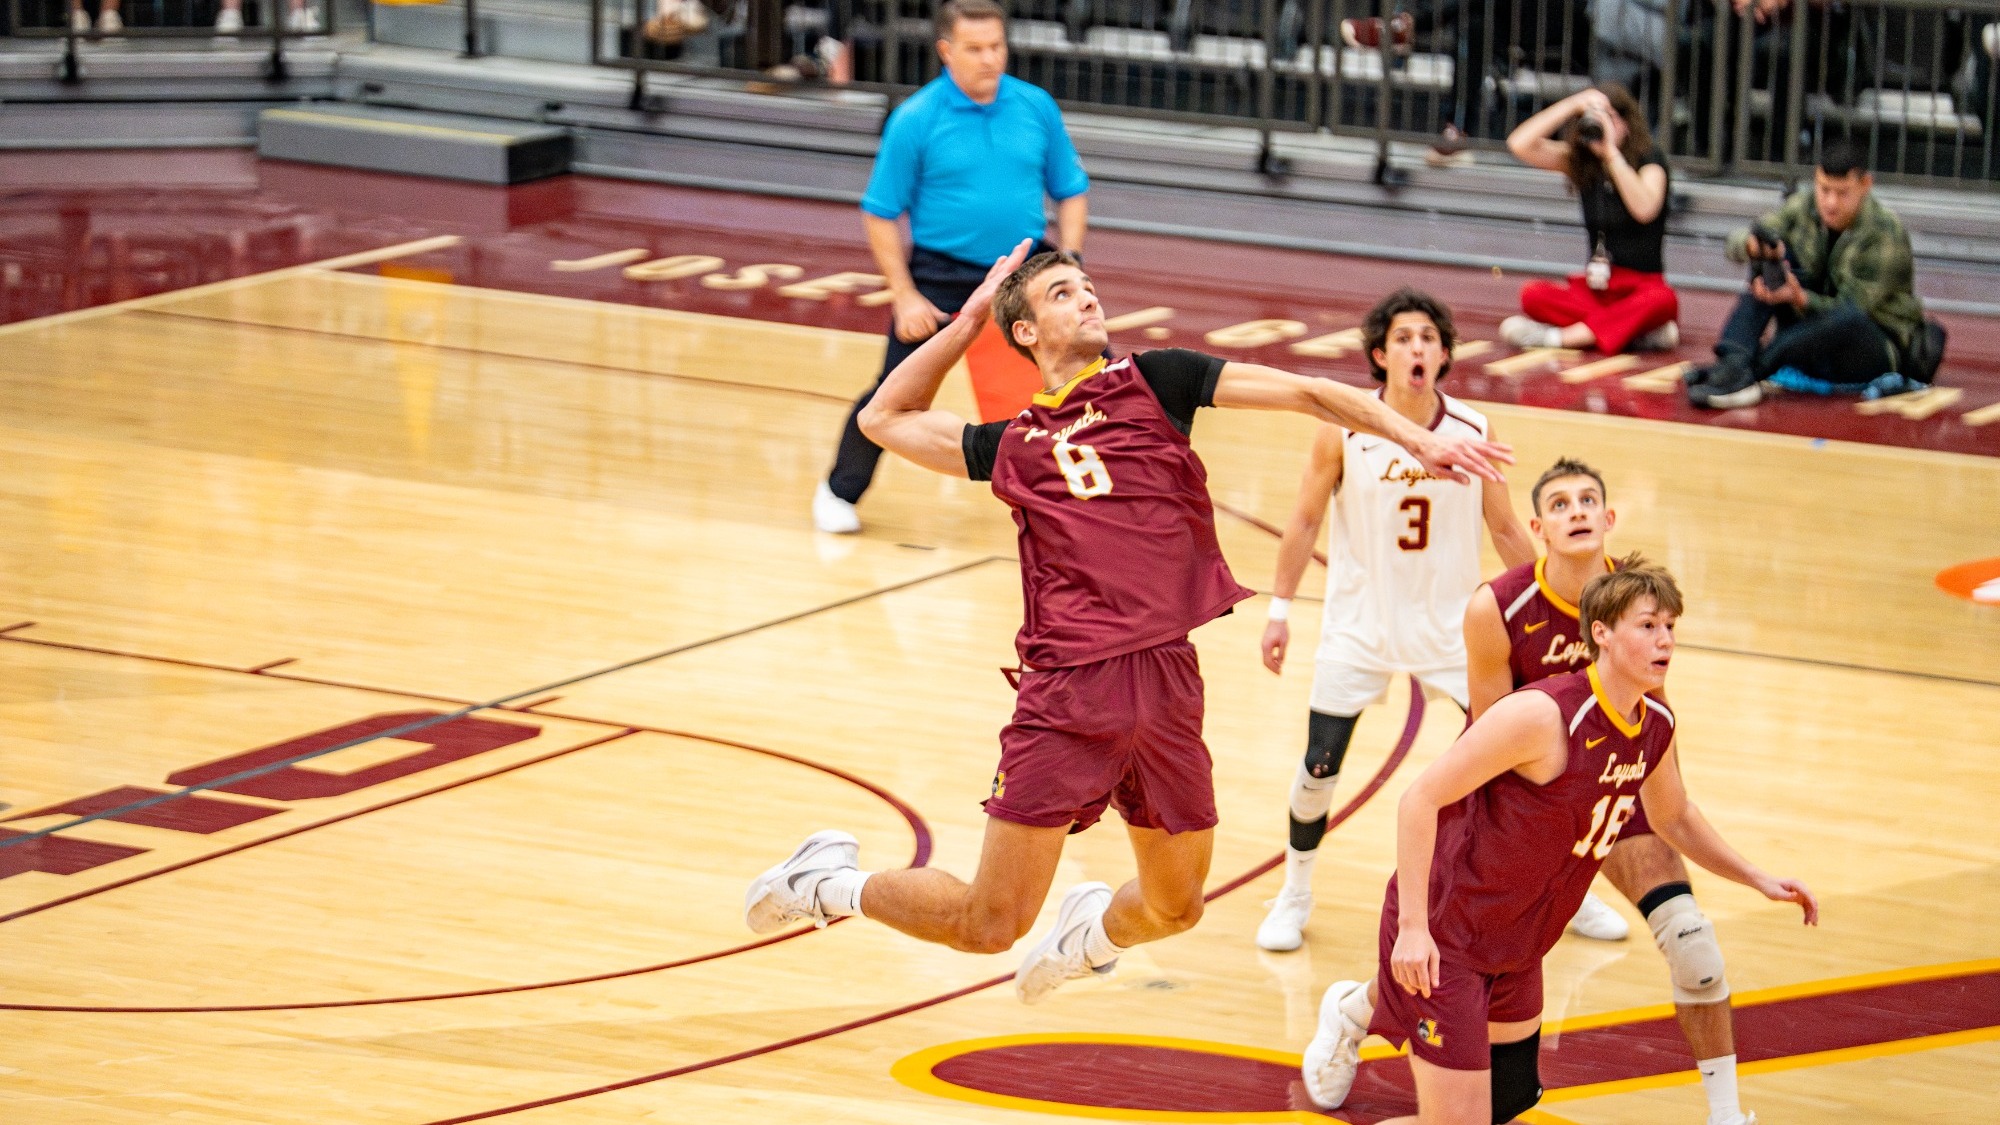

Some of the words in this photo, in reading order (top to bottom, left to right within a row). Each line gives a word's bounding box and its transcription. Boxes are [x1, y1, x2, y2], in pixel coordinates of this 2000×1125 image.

[551, 248, 895, 307] JOSE
[1203, 319, 1692, 394] GETIL
[1052, 440, 1114, 501] 8
[1379, 458, 1442, 488] Loyo
[1397, 497, 1431, 551] 3
[1541, 633, 1591, 666] Loy
[1598, 749, 1647, 789] Loyola
